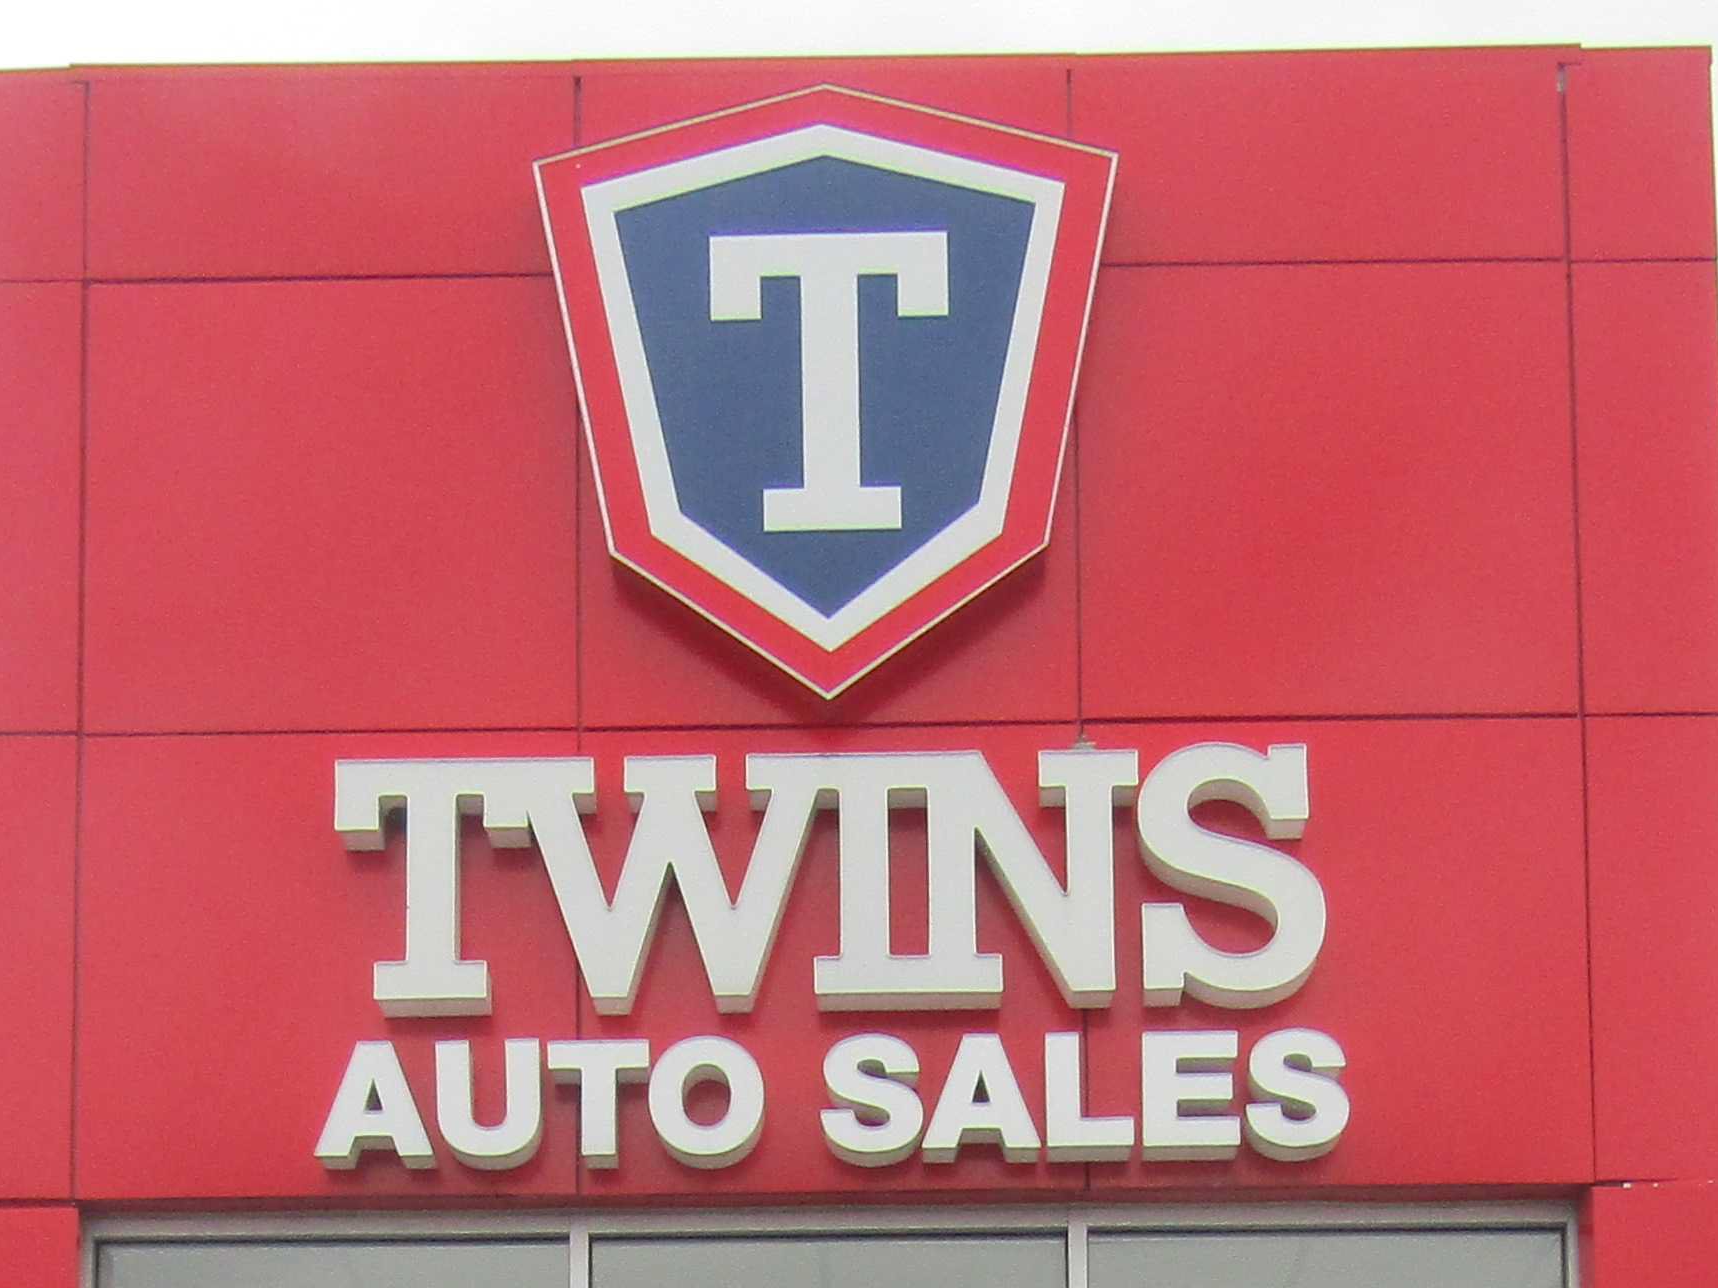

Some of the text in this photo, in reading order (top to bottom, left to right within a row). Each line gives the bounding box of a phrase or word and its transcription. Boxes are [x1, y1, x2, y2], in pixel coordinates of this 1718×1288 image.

[708, 231, 949, 532] T
[334, 741, 1327, 1017] TWINS
[314, 1027, 1351, 1171] AUTO SALES
